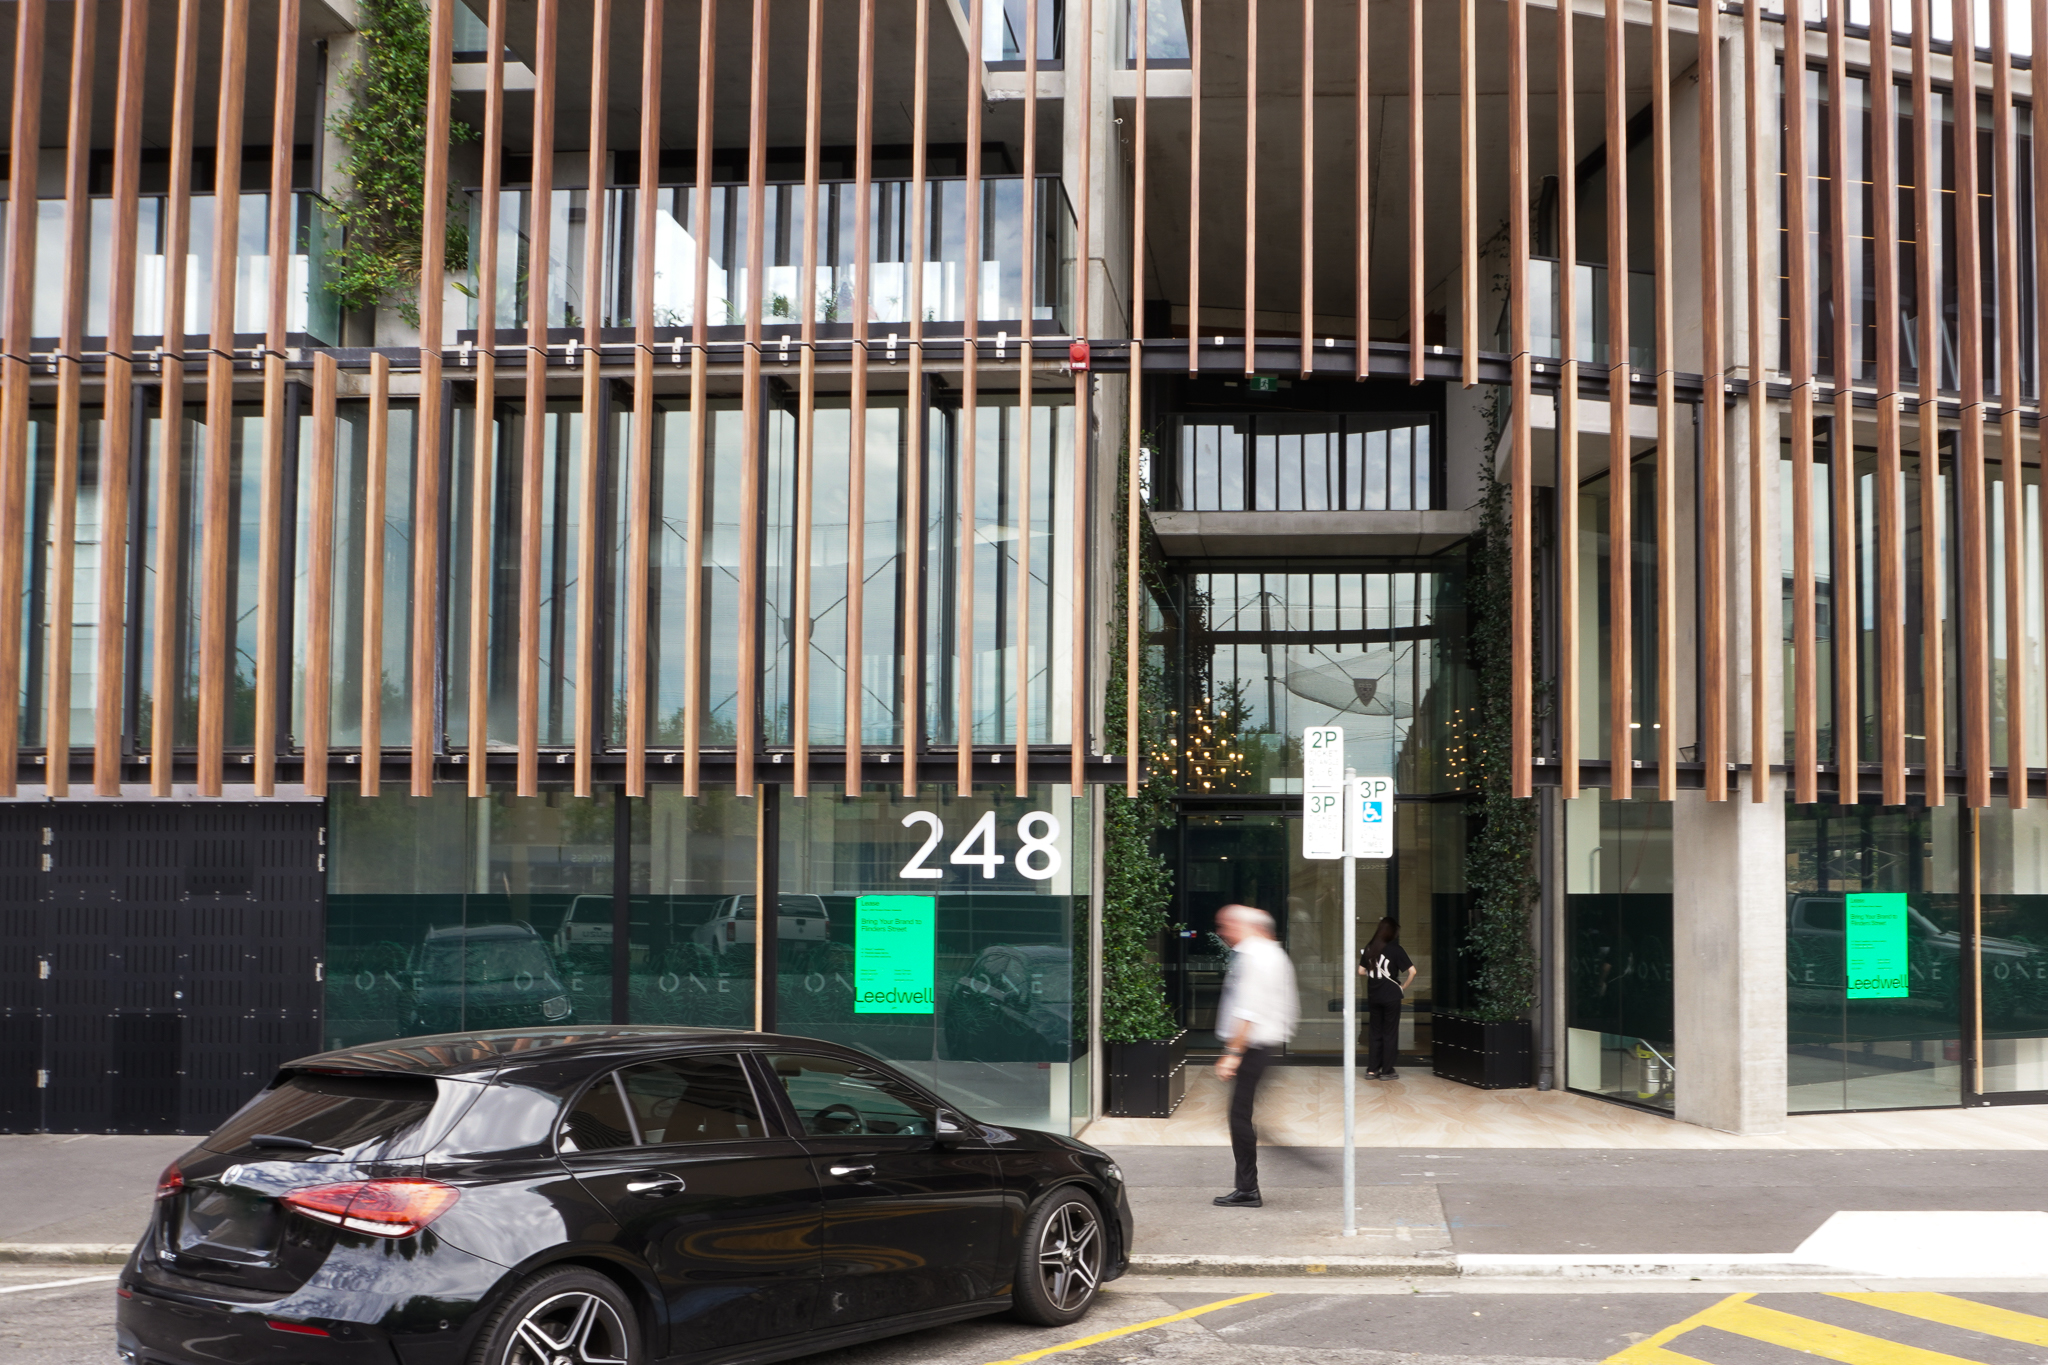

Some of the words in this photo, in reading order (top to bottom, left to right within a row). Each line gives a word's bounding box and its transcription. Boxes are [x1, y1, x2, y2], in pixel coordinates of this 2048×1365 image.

[1312, 731, 1337, 749] 2P
[1360, 781, 1387, 799] 3P
[1311, 796, 1335, 813] 3P
[899, 810, 1062, 880] 248
[1909, 962, 1942, 980] NE
[1993, 962, 2047, 979] ONE
[355, 970, 425, 991] ONE
[514, 970, 585, 991] ONE
[658, 971, 731, 993] ONE
[970, 972, 1043, 994] ONE
[1847, 975, 1909, 989] Leedwell
[854, 986, 935, 1004] Leedwell
